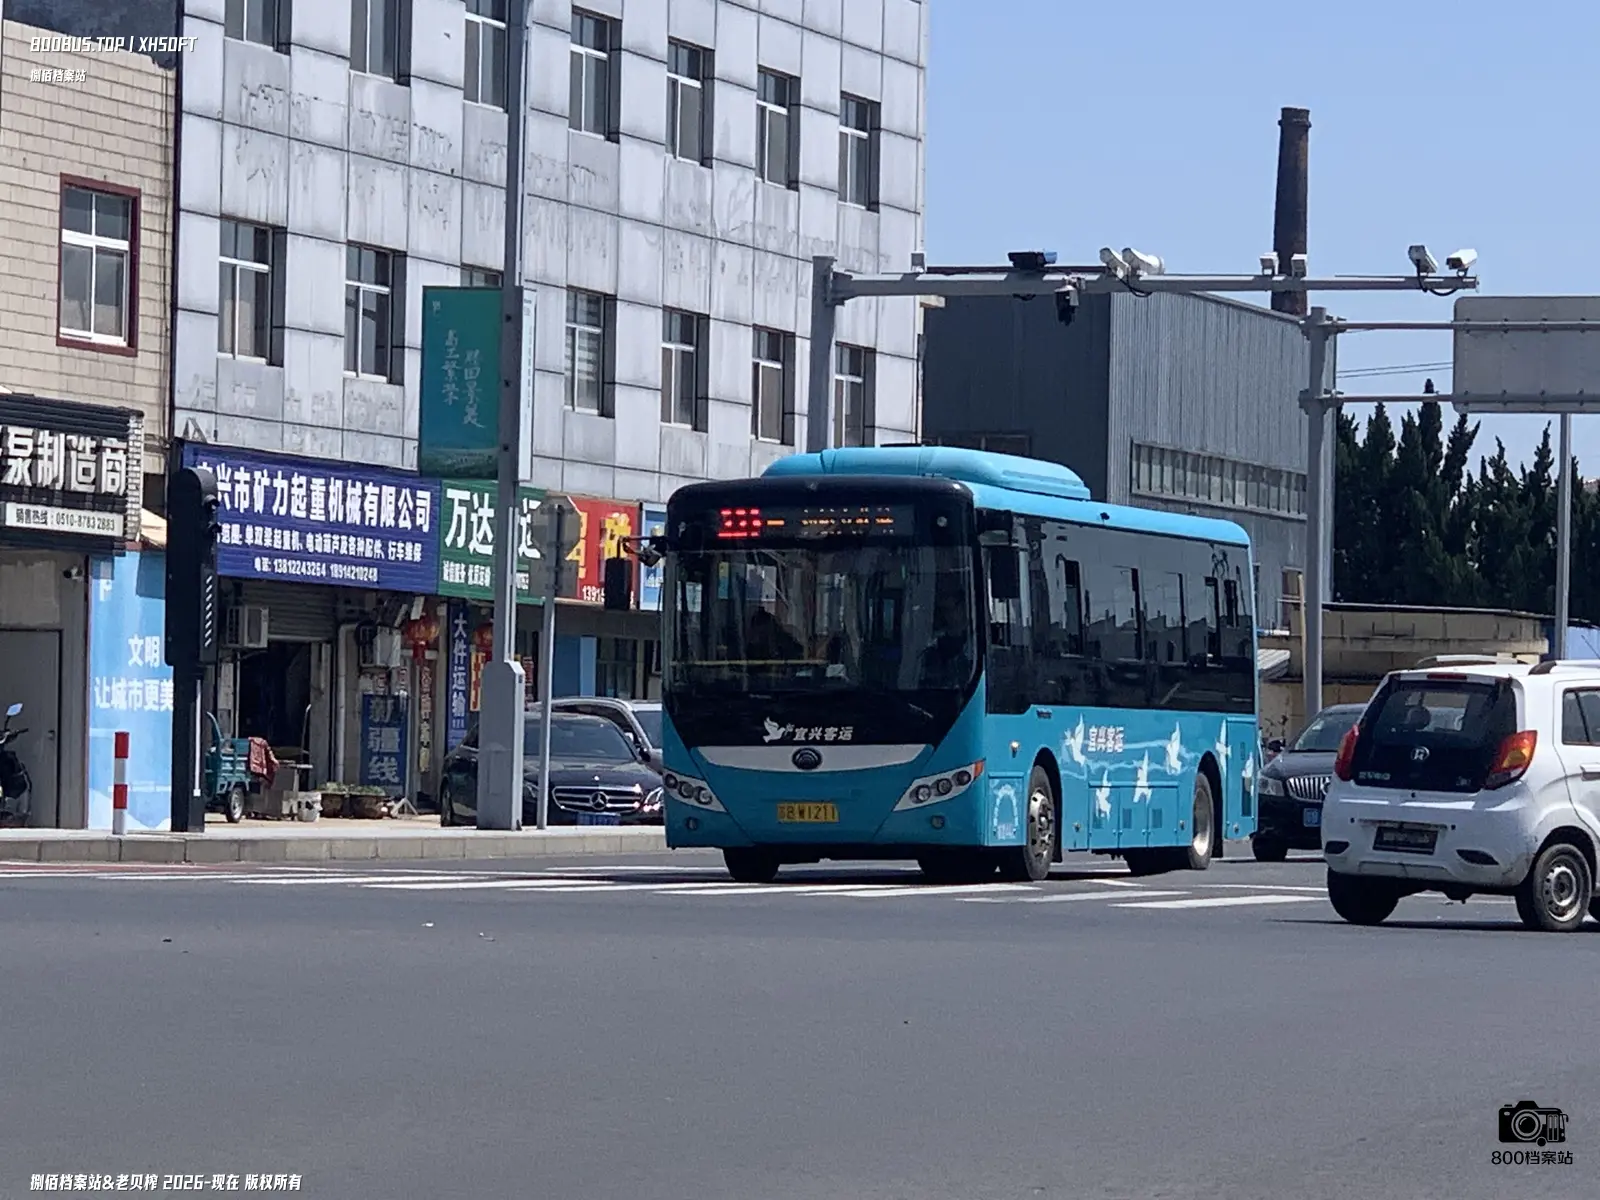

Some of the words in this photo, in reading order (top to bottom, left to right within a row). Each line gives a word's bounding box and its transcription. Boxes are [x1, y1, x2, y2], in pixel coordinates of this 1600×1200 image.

[0, 425, 128, 496] 泵制造商
[127, 633, 161, 668] 文明
[94, 676, 174, 712] 让城市更美
[793, 726, 854, 741] 宜兴客运
